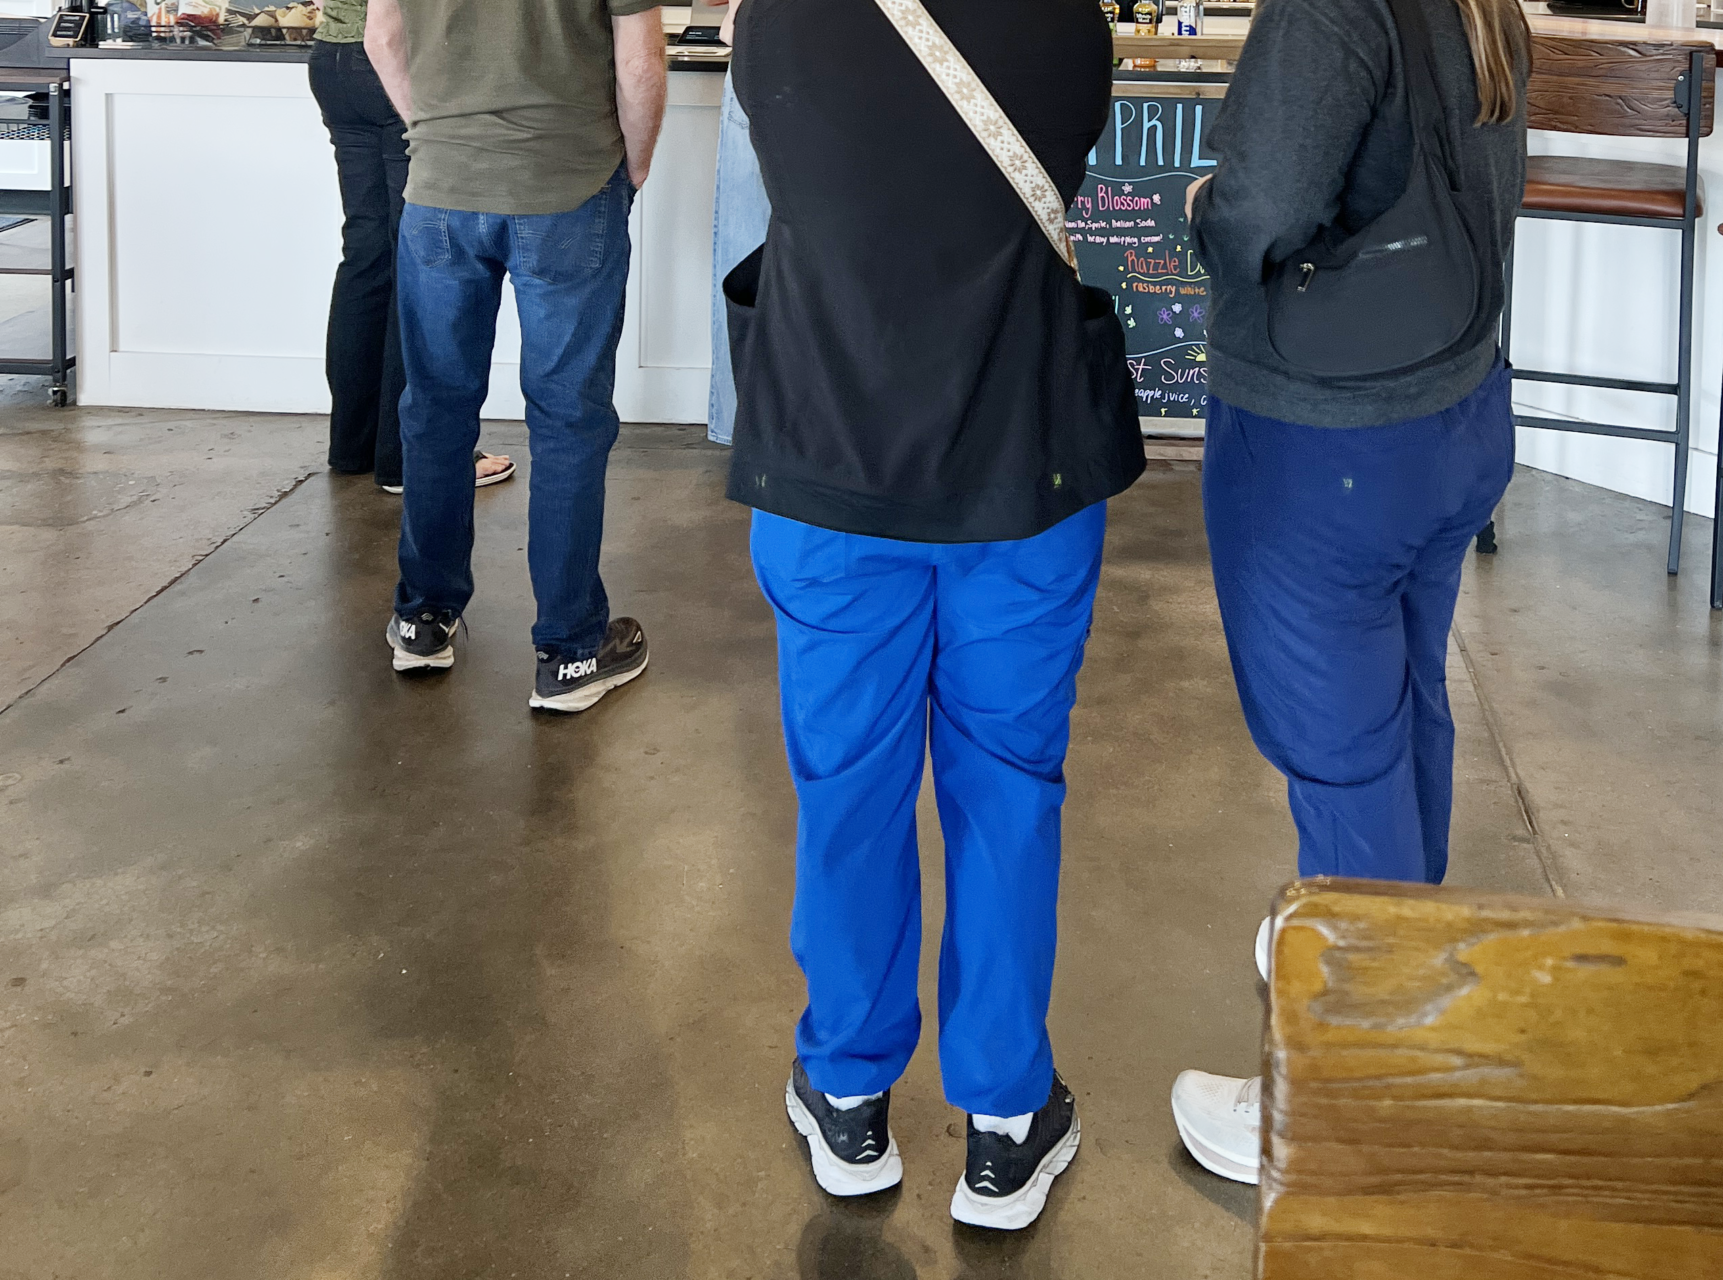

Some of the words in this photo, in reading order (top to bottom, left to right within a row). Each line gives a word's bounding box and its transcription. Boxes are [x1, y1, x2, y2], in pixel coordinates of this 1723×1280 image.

[1097, 184, 1152, 211] Blossom
[1112, 219, 1134, 228] Italian
[1136, 218, 1155, 227] Soda
[1087, 234, 1107, 245] heavy
[1109, 235, 1138, 246] whipping
[1124, 250, 1180, 274] Razzle
[1132, 282, 1176, 298] rasberry
[1179, 286, 1207, 295] white
[558, 657, 598, 681] HOKA
